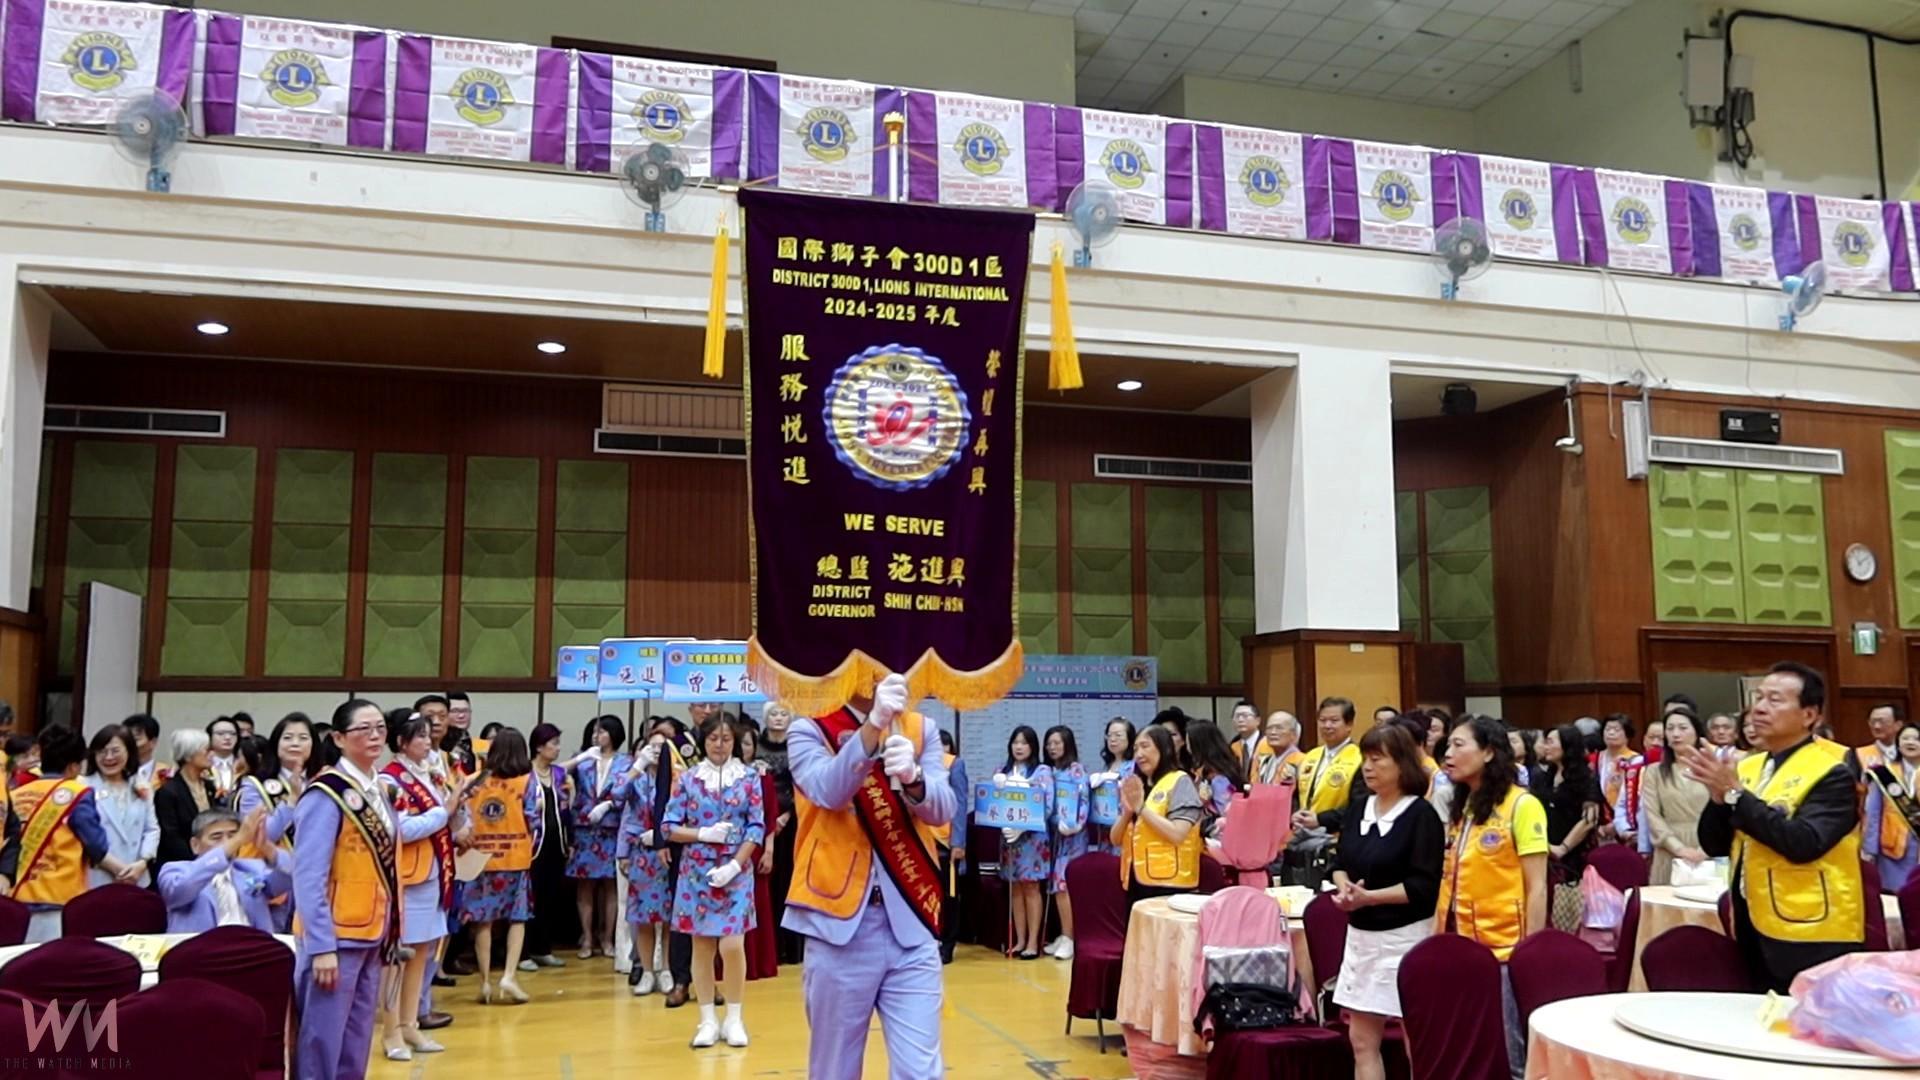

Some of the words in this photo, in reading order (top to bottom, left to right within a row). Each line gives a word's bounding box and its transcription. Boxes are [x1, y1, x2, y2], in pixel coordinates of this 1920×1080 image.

[91, 49, 110, 71] L
[288, 66, 305, 88] L
[820, 123, 837, 144] L
[975, 139, 990, 158] L
[1120, 154, 1134, 173] L
[1259, 171, 1273, 190] L
[772, 269, 830, 289] DISTRICT
[831, 274, 861, 291] 300D
[914, 282, 1009, 302] INTERNATIONAL
[824, 297, 917, 322] 2024-2025
[844, 513, 875, 531] WE
[885, 515, 945, 537] SERVE
[816, 554, 870, 581] 總監
[812, 585, 872, 600] DISTRICT
[884, 592, 912, 611] SHIH
[808, 603, 876, 619] GOVERNOR
